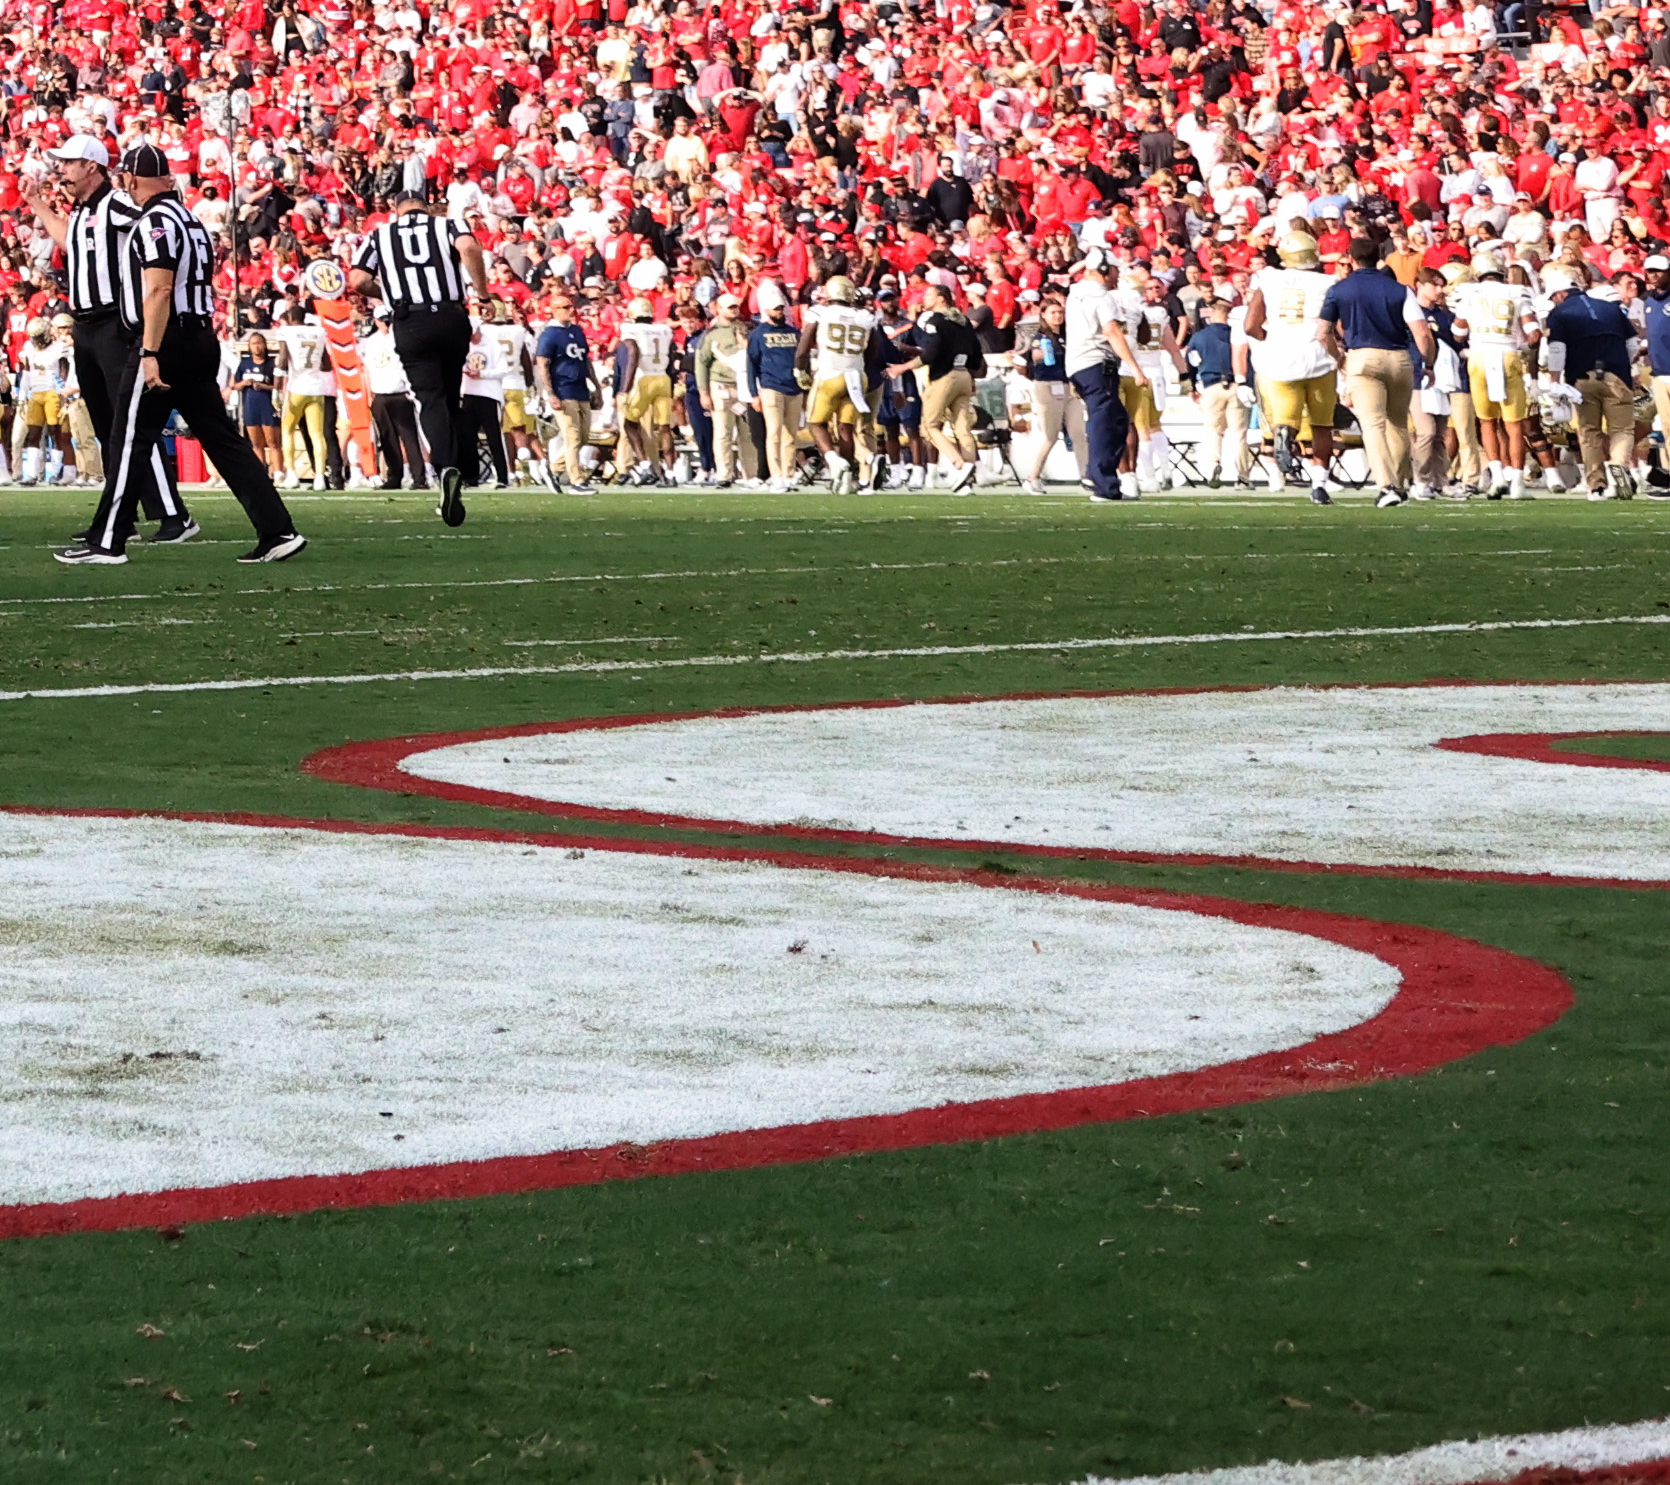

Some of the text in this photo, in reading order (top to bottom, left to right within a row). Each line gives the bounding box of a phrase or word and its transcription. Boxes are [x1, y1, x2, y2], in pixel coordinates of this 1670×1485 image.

[188, 228, 209, 281] F
[398, 224, 431, 264] U
[313, 267, 342, 293] SEC
[652, 337, 661, 365] 1
[763, 332, 798, 345] TECH
[826, 323, 870, 355] 99
[301, 341, 317, 369] 7
